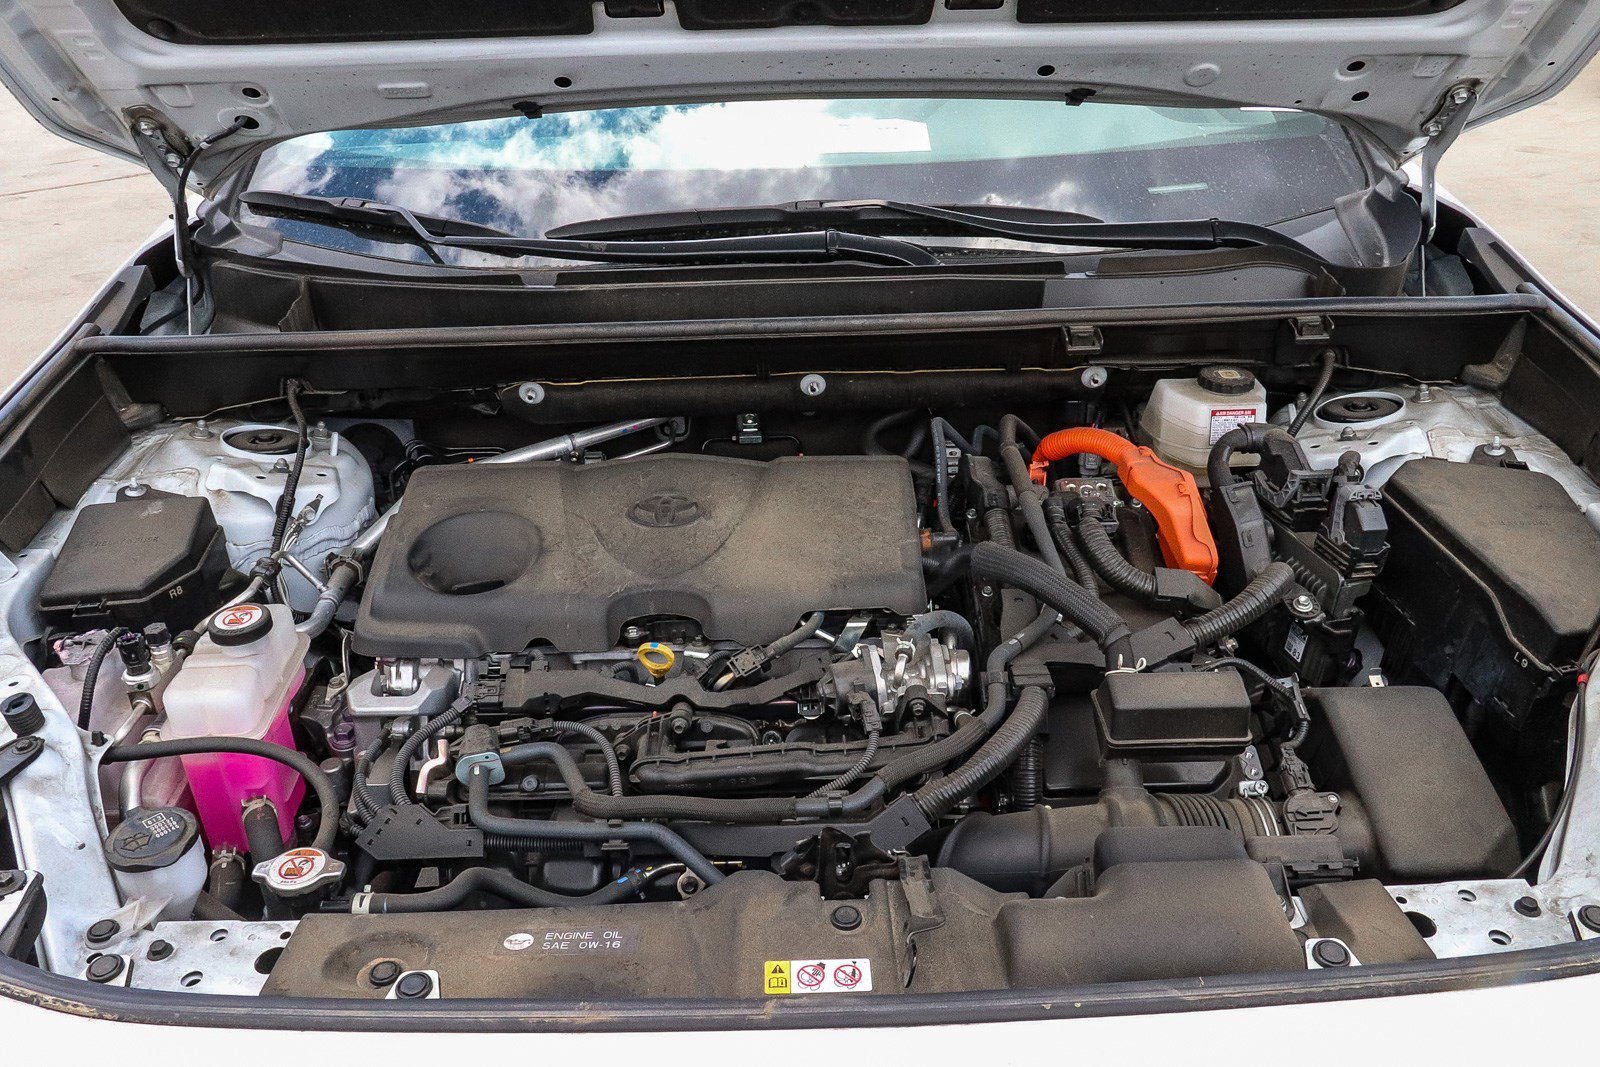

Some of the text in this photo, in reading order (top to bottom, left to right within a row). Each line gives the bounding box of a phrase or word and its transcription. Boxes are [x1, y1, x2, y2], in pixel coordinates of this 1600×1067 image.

[169, 585, 184, 599] R8
[1514, 651, 1528, 668] L9
[545, 931, 623, 941] ENGINE OIL
[542, 940, 621, 950] SAE 0W-16
